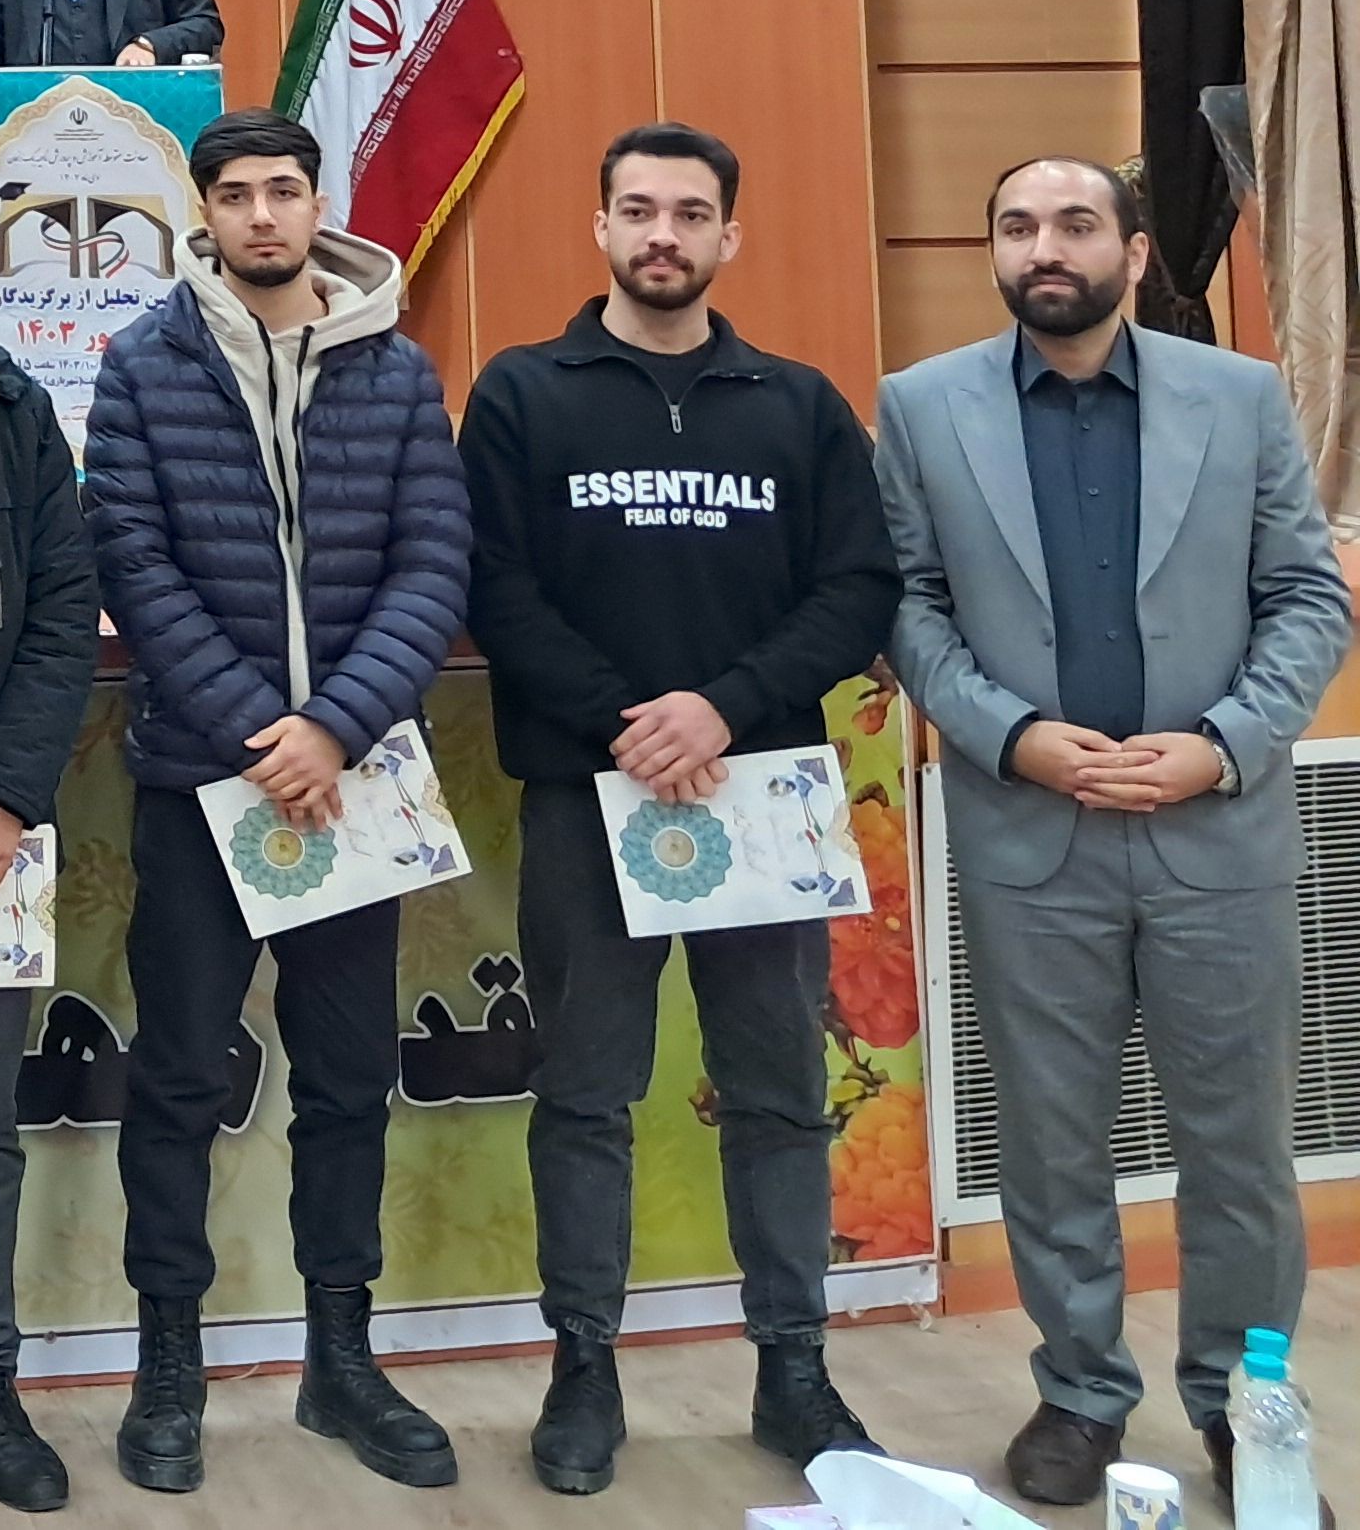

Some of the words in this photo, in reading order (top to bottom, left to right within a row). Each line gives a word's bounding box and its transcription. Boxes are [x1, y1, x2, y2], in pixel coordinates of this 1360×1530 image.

[76, 288, 91, 310] از
[95, 288, 140, 310] تجلیل
[17, 319, 76, 346] ۱۴۰۳
[568, 470, 776, 511] ESSENTIALS
[625, 508, 667, 526] FEAR
[670, 508, 691, 525] OF
[693, 509, 727, 528] GOD
